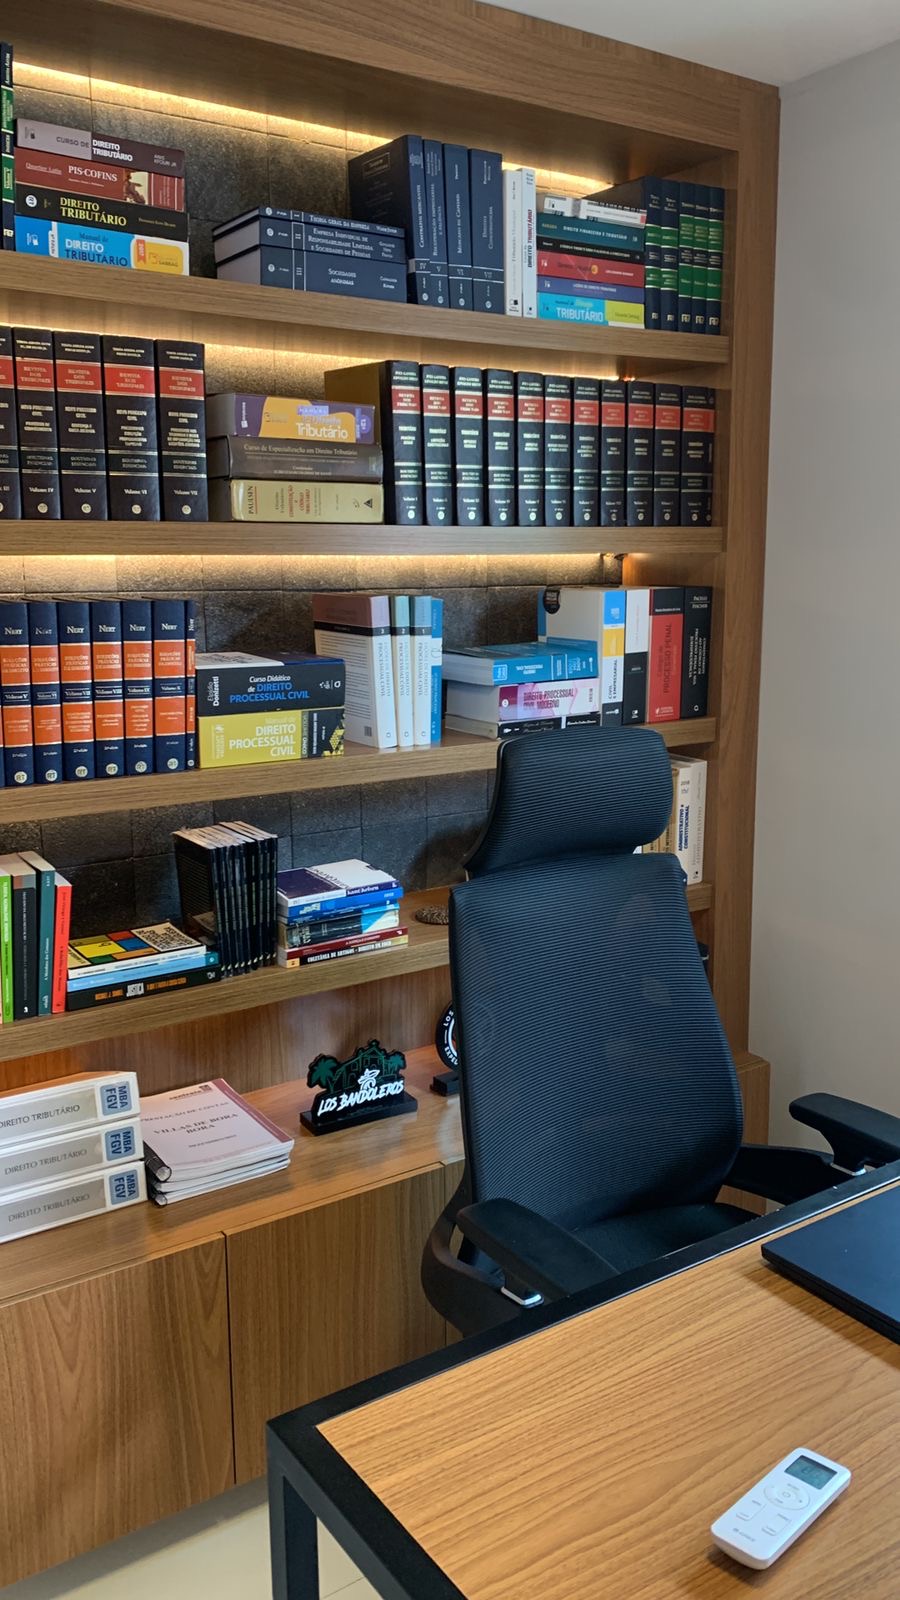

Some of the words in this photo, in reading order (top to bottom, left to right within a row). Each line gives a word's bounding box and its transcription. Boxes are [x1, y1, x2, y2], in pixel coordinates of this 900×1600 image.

[56, 136, 79, 147] CURSO
[92, 139, 121, 152] DIREITO
[92, 147, 133, 163] TRIBUTÁRIO
[60, 196, 100, 212] DIREITO
[60, 206, 128, 228] TRIBUTÁRIO
[65, 239, 104, 253] DIREITO
[64, 250, 128, 268] TRIBUTÁRIO
[556, 306, 604, 322] TRIBUTÁRIO
[296, 422, 349, 440] Tributário
[268, 446, 306, 455] Especialização
[257, 682, 292, 692] DIREITO
[524, 691, 543, 701] DIREITO
[543, 688, 574, 700] PROCESSUAL
[230, 694, 286, 704] PROCESSUAL
[288, 691, 310, 700] CIVIL
[537, 699, 560, 710] MODERNO
[256, 723, 296, 736] DIREITO
[229, 736, 296, 750] PROCESSUAL
[270, 746, 296, 757] CIVIL
[443, 1010, 454, 1026] LOS
[106, 1088, 116, 1110] FGV
[118, 1085, 129, 1108] MBA
[317, 1095, 337, 1116] LOS
[337, 1080, 404, 1111] BANDOLEROS
[0, 1115, 30, 1130] DIREITO
[32, 1104, 80, 1122] TRIBUTÁRIO
[154, 1124, 192, 1134] VILLAS
[193, 1120, 208, 1129] DE
[210, 1113, 239, 1124] BORA
[186, 1124, 215, 1134] BORA
[110, 1134, 122, 1155] FGV
[123, 1131, 132, 1153] MBA
[4, 1158, 38, 1175] DIREITO
[39, 1148, 88, 1166] TRIBUTÁRIO
[114, 1177, 125, 1198] FGV
[126, 1174, 136, 1197] MBA
[8, 1206, 41, 1222] DIREITO
[43, 1192, 90, 1212] TRIBUTÁRIO
